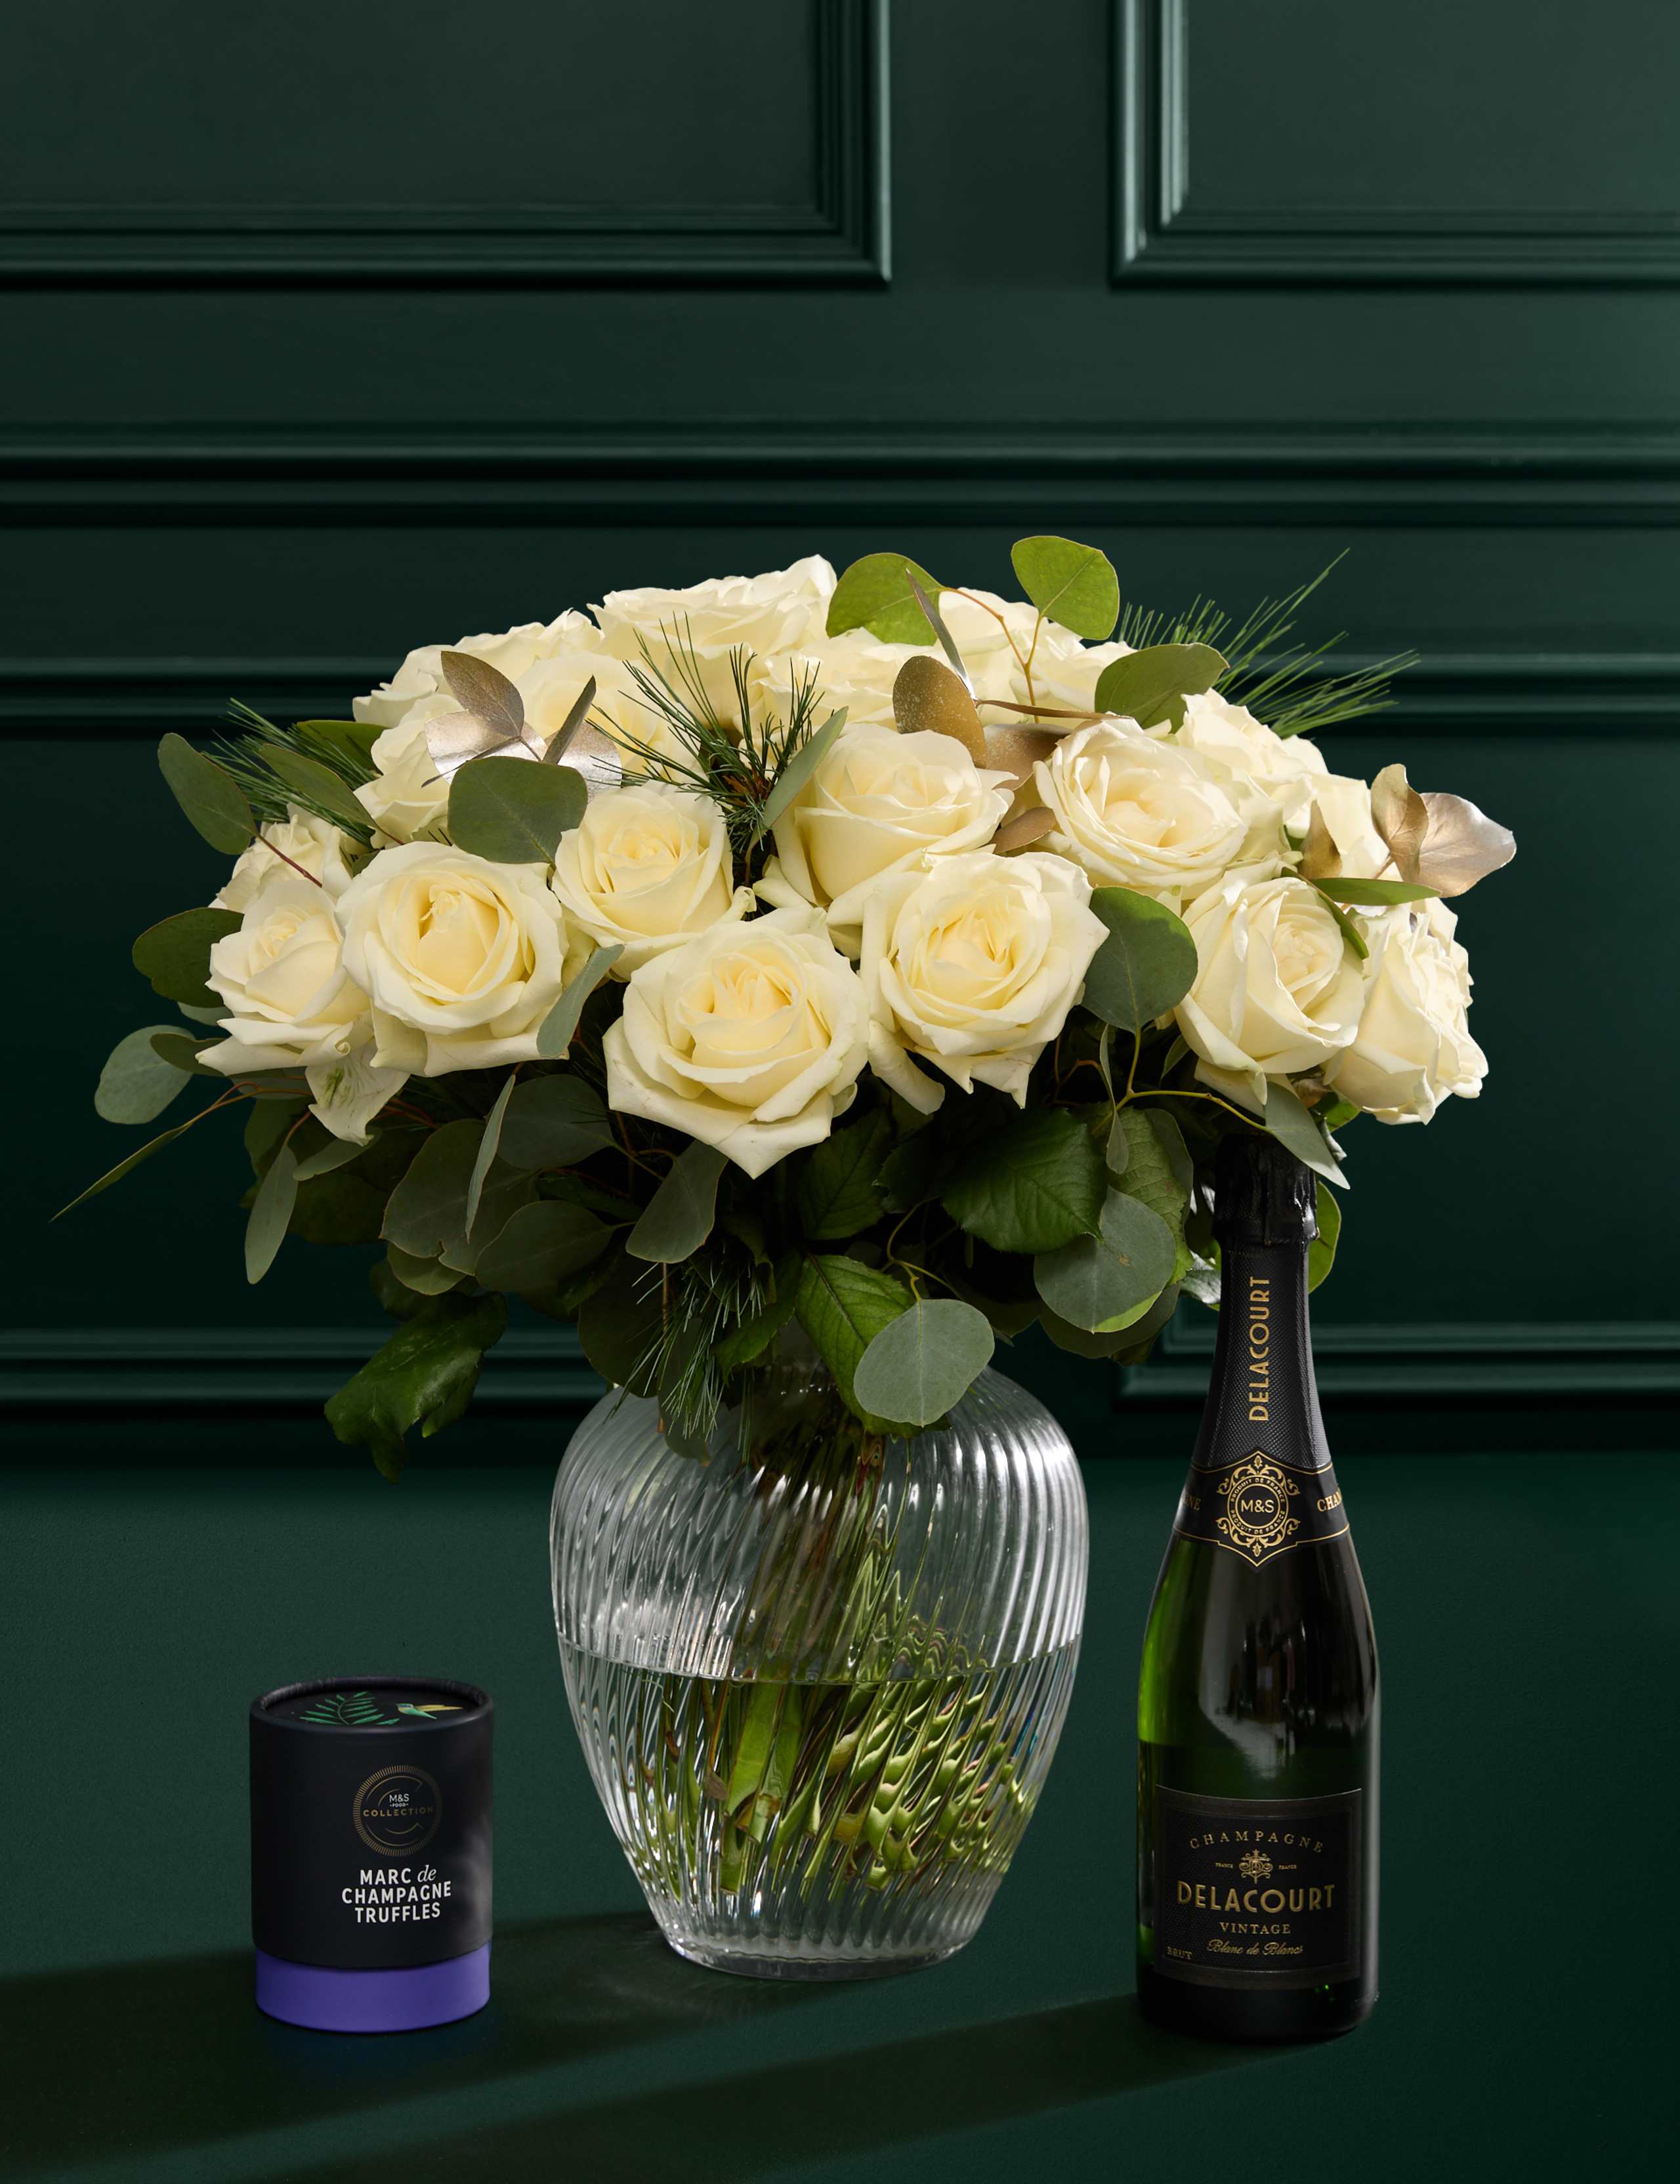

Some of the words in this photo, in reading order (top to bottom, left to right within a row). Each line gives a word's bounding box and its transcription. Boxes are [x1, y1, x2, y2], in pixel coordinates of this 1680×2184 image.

[1249, 1276, 1270, 1421] DELACOURT
[1230, 1479, 1252, 1502] PRODUIT
[1267, 1479, 1286, 1503] FRANCE
[1241, 1499, 1274, 1513] M&S
[1230, 1509, 1252, 1532] PRODUIT
[1266, 1511, 1286, 1532] FRANCE
[389, 1794, 410, 1803] M&S
[363, 1807, 433, 1817] COLLECTION
[1190, 1830, 1324, 1853] CHAMPAGNE
[360, 1868, 411, 1885] MARC
[417, 1864, 436, 1883] de
[342, 1881, 452, 1904] CHAMPAGNE
[1177, 1881, 1335, 1913] DELACOURT
[355, 1902, 440, 1923] TRUFFLES
[1219, 1922, 1292, 1934] VINTAGE
[1167, 1946, 1192, 1960] BRUT
[1207, 1939, 1244, 1954] Blanc
[1246, 1942, 1259, 1955] de
[1263, 1942, 1303, 1955] Blancs
